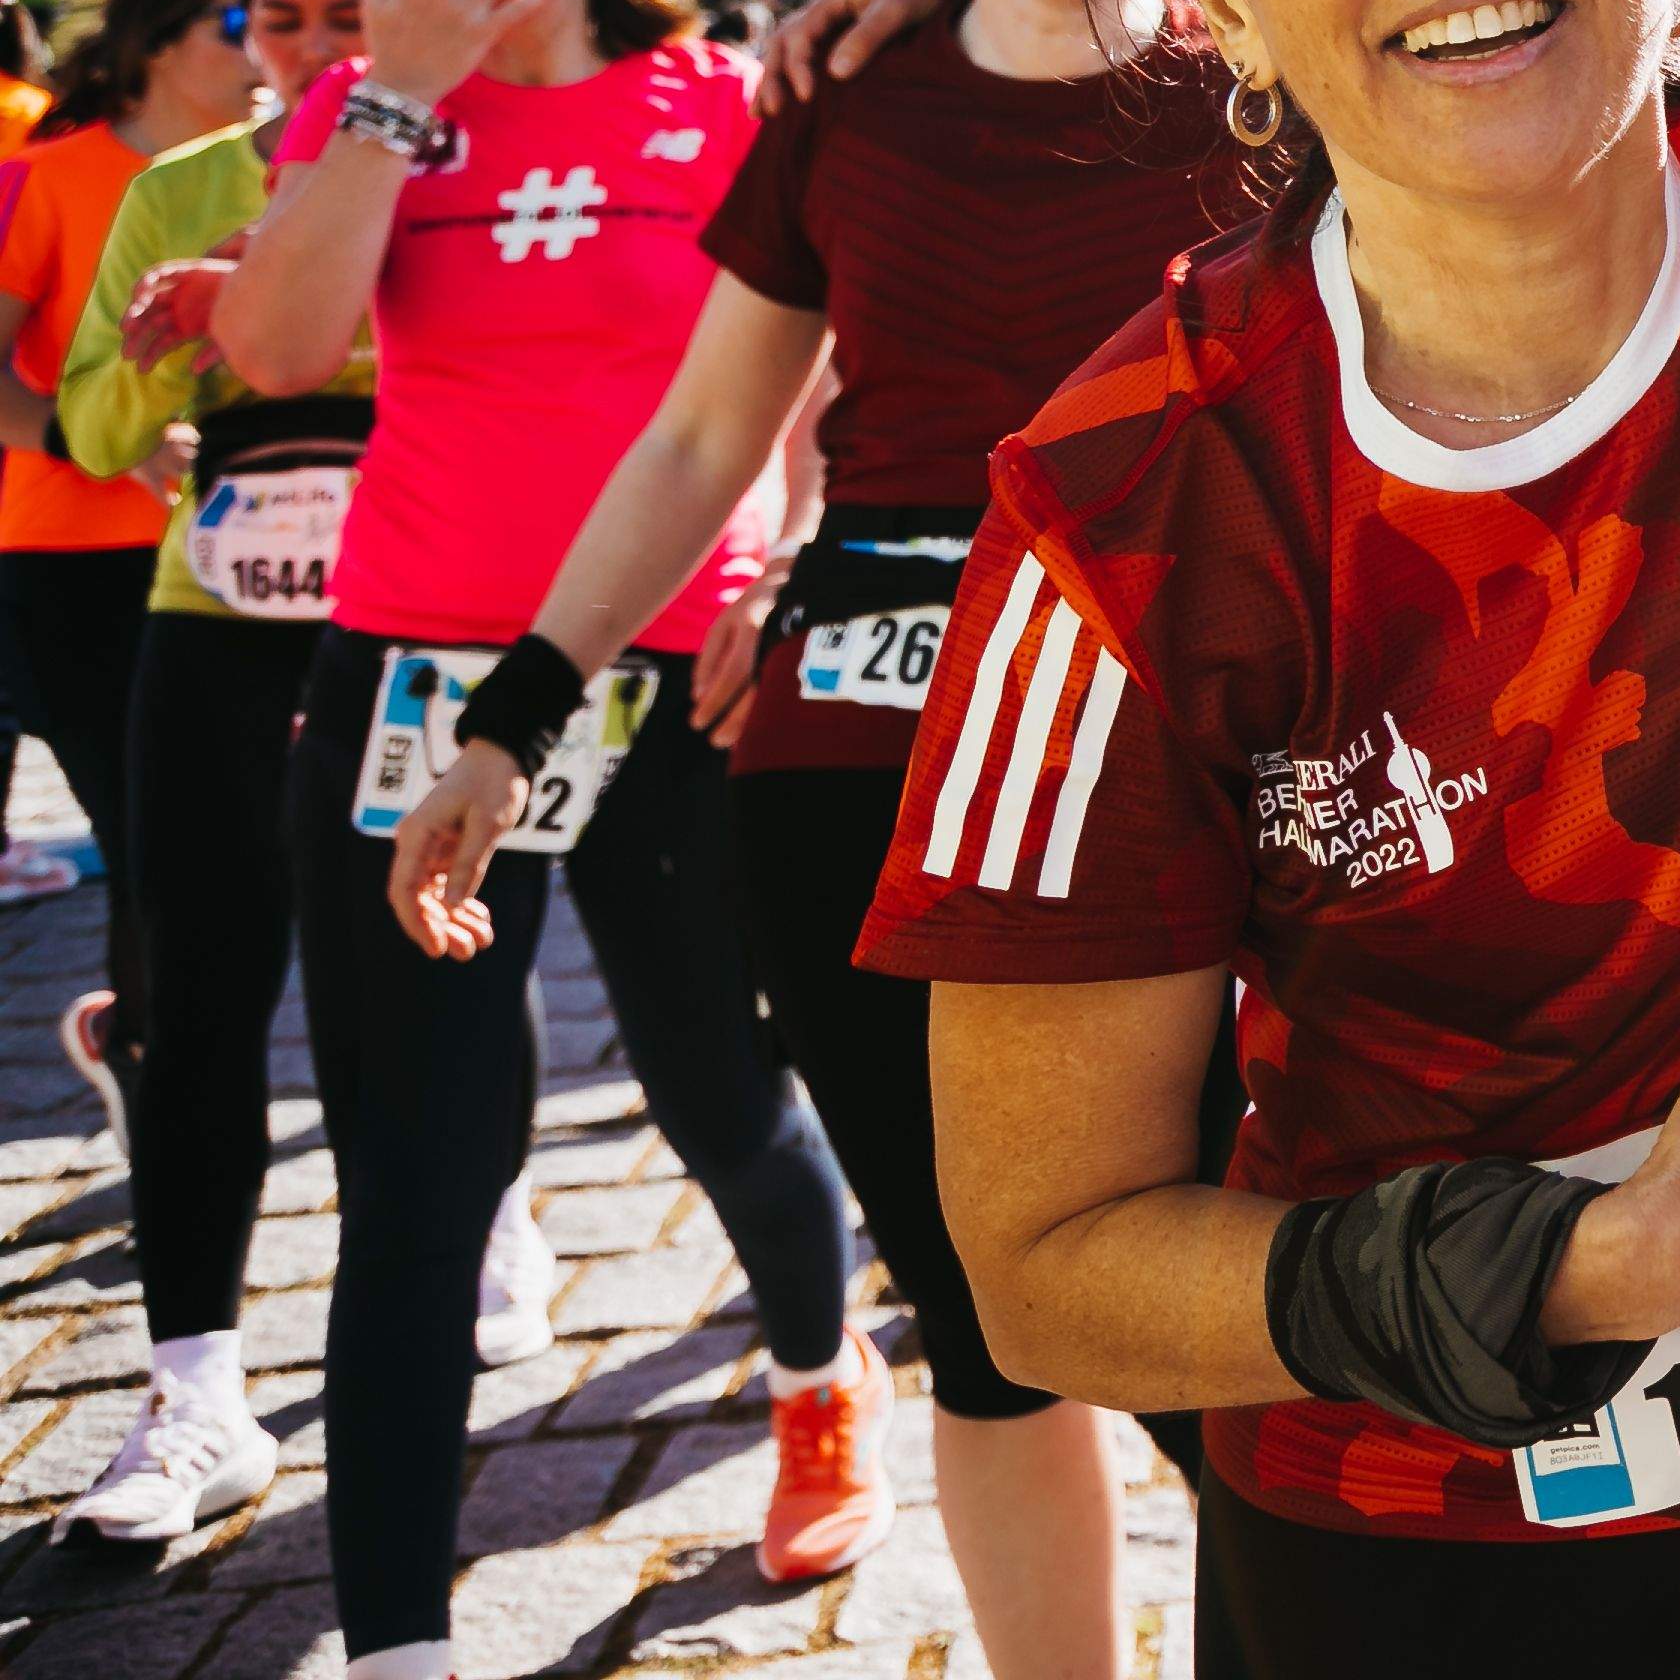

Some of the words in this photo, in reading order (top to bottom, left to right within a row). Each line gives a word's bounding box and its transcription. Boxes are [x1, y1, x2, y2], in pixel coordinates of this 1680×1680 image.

[231, 557, 325, 602] 1644
[861, 617, 940, 685] 26
[1346, 837, 1420, 889] 2022
